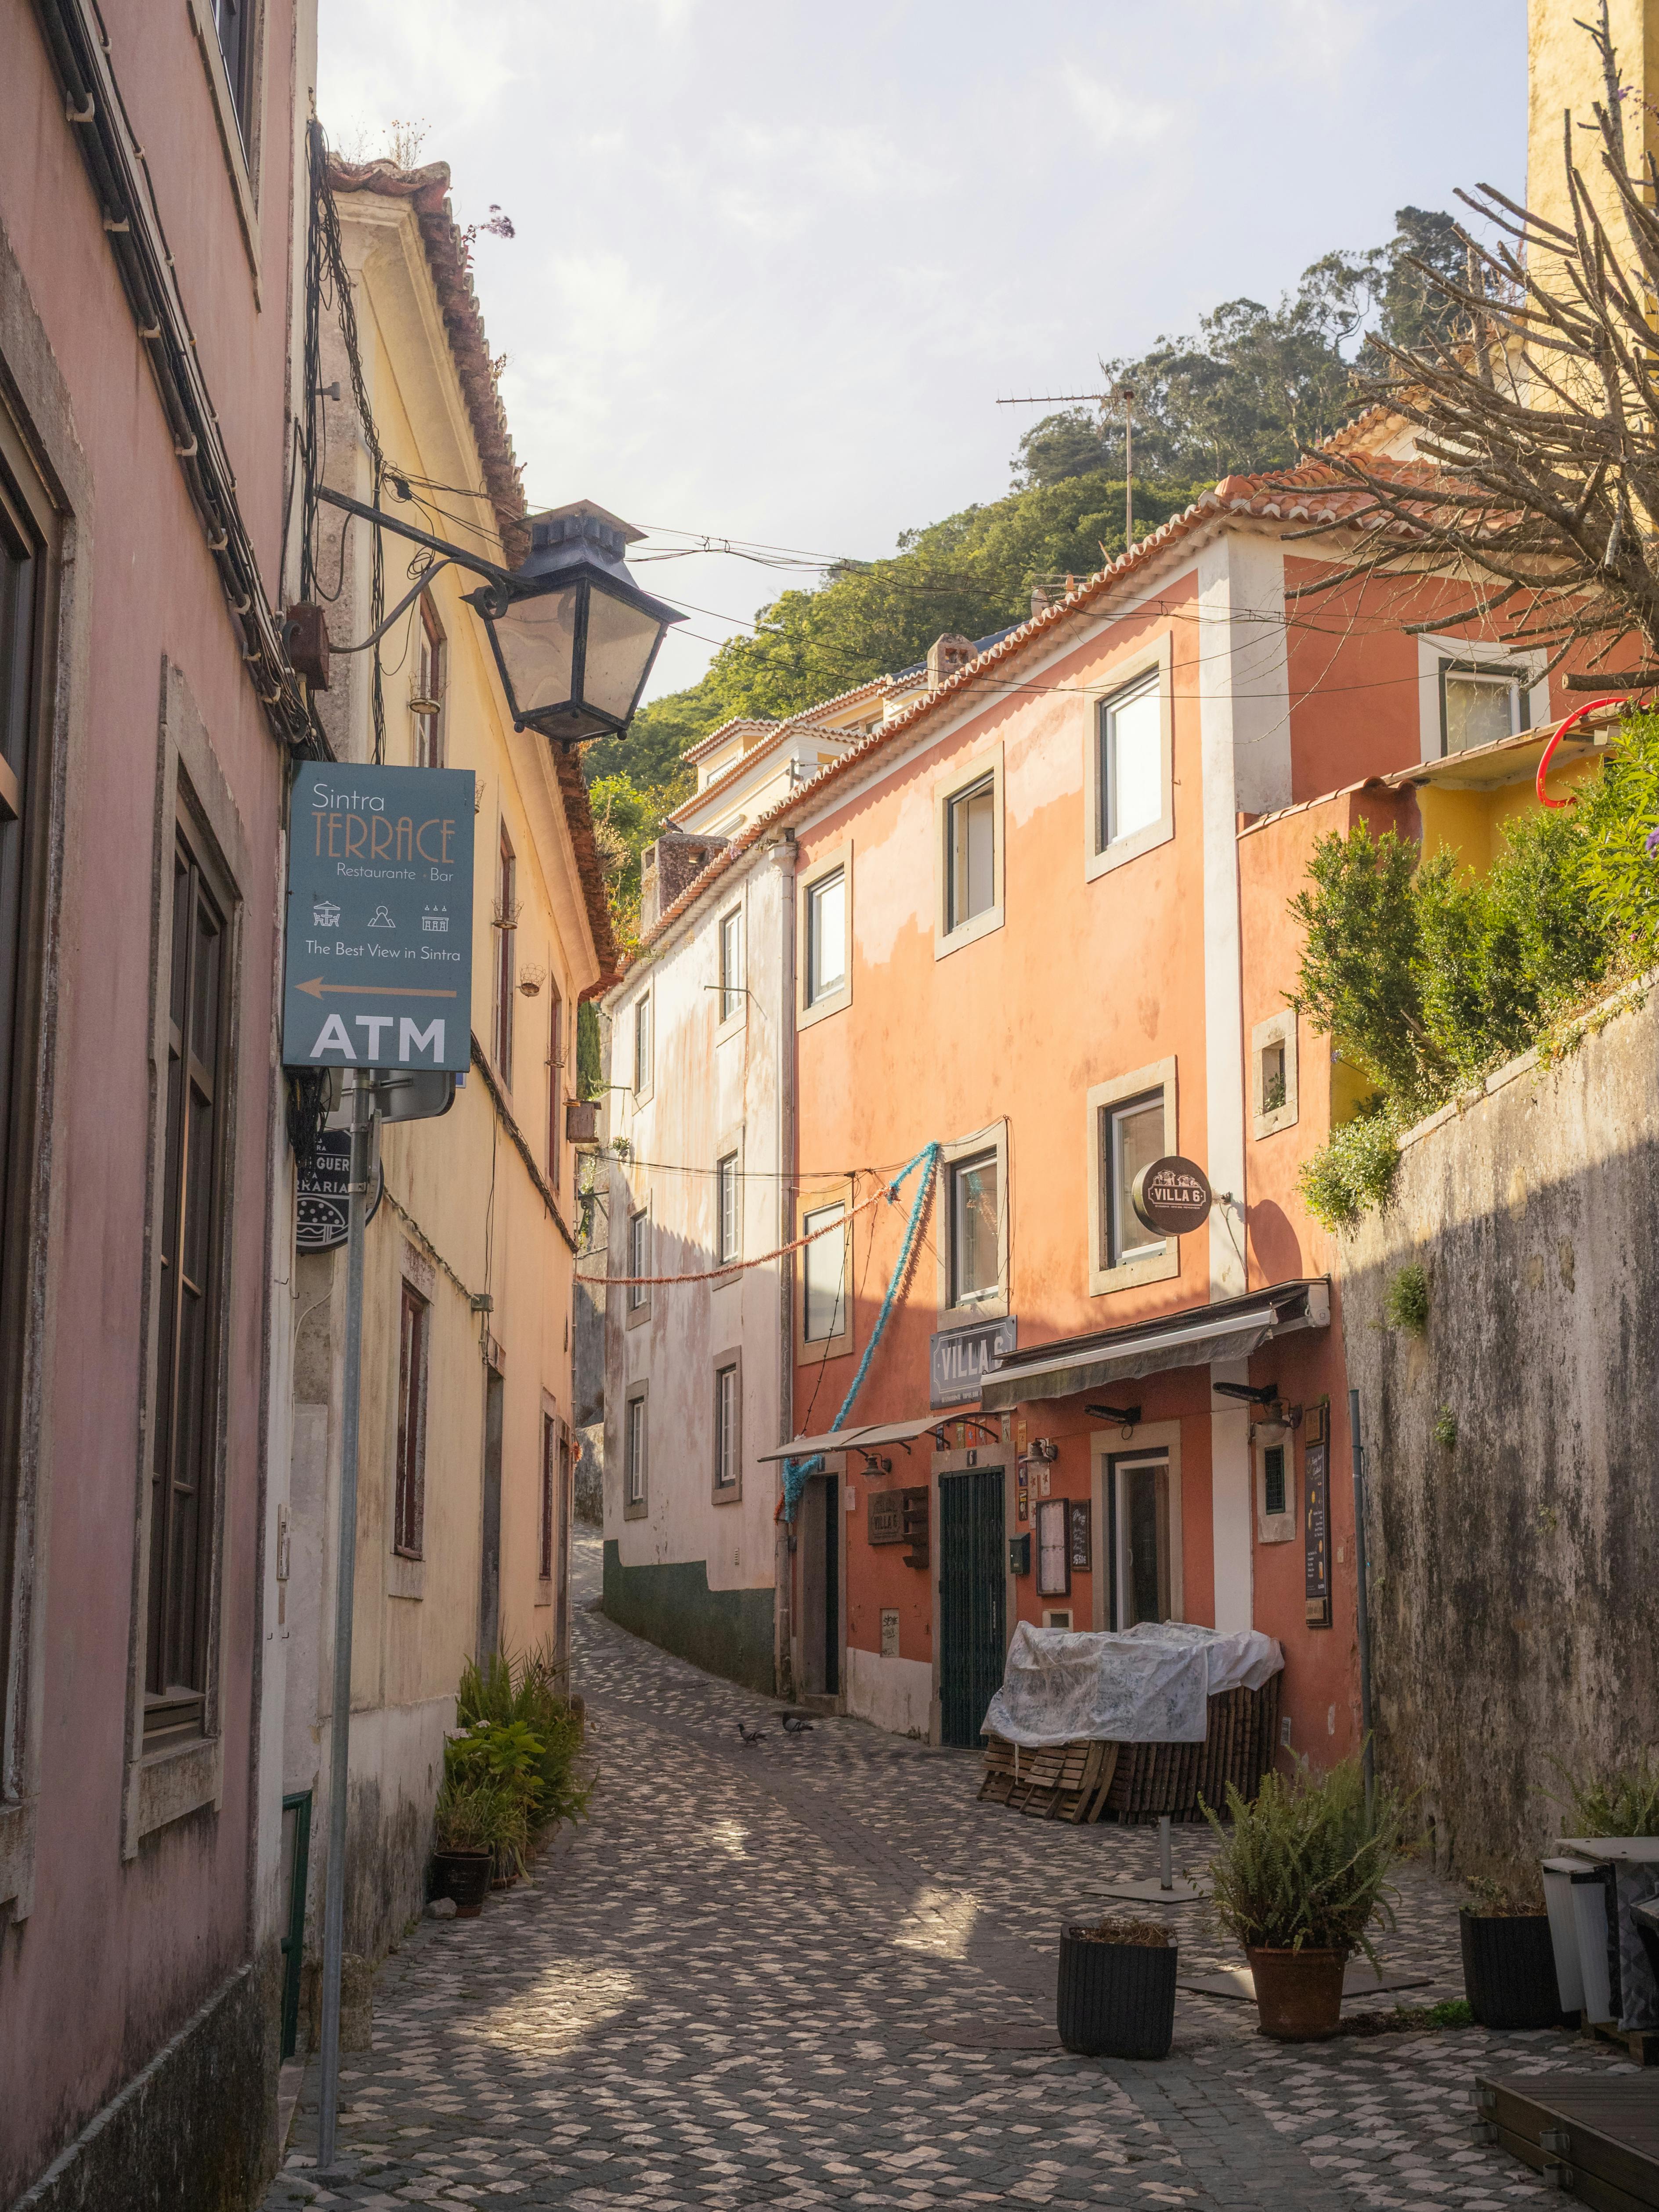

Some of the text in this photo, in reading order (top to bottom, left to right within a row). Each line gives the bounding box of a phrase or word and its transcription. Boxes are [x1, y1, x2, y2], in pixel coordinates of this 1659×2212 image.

[312, 783, 384, 811] Sintra
[312, 812, 455, 864] TERRACE
[337, 862, 454, 882] Restaurante Bar
[306, 940, 460, 961] The Best View in Sintra
[310, 1014, 445, 1063] ATM
[1154, 1188, 1200, 1202] VILLA 6
[941, 1339, 988, 1380] VILLA
[969, 1451, 973, 1464] 6
